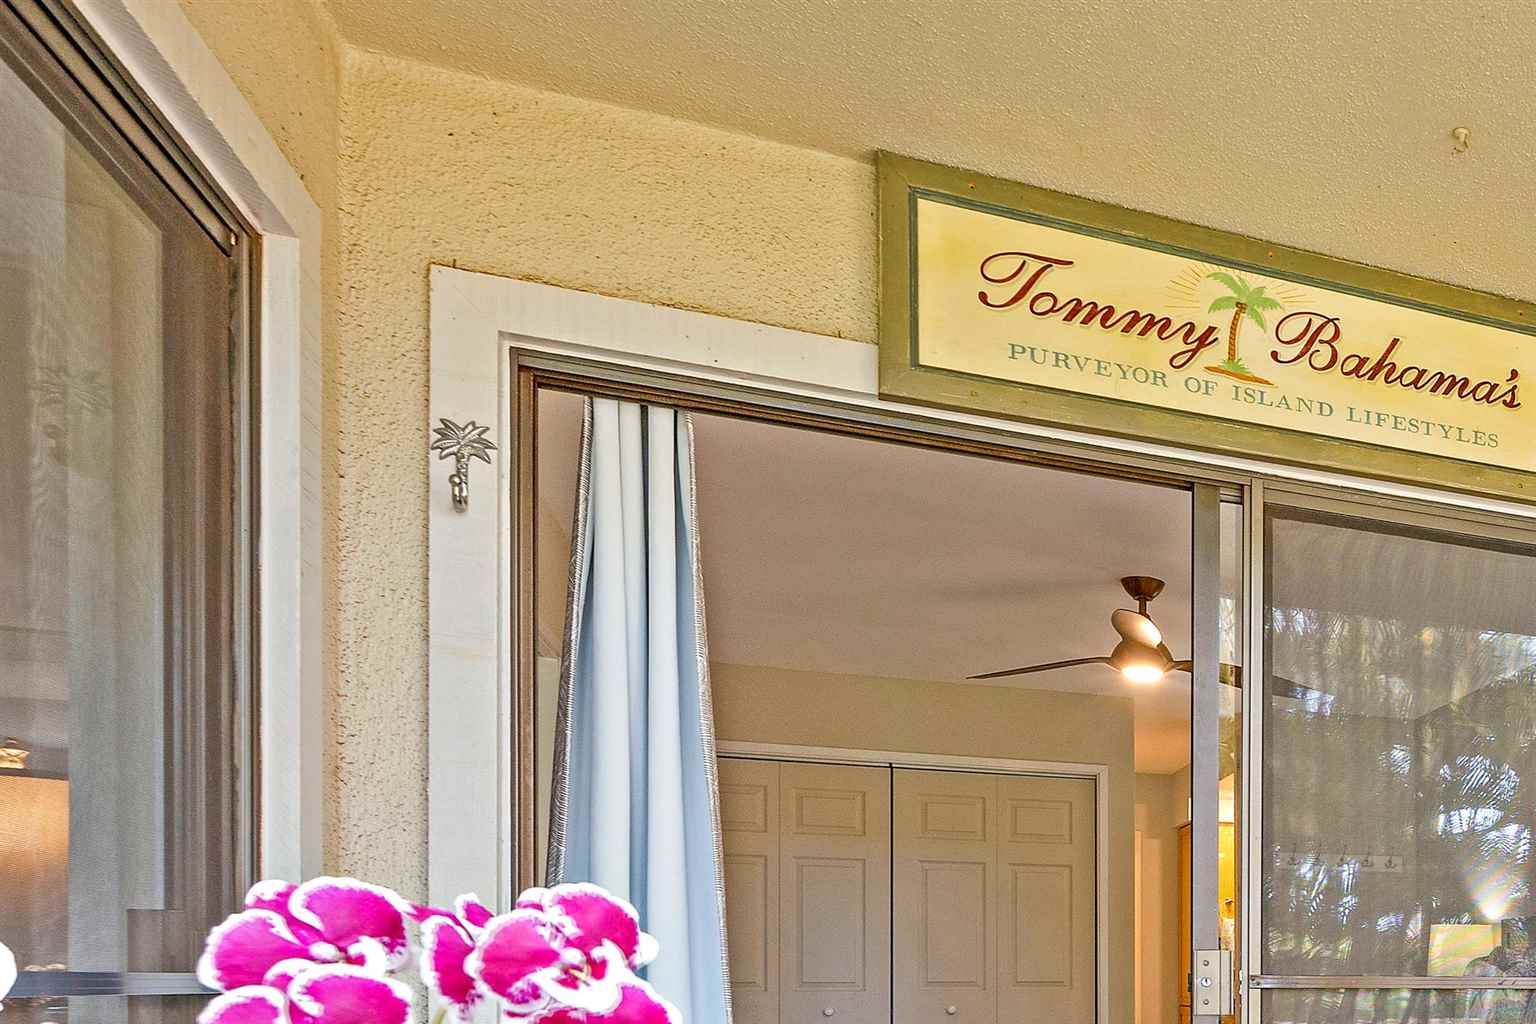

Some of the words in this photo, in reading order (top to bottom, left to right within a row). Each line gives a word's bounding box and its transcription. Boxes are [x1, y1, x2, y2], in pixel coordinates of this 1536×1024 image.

[978, 251, 1218, 369] Tommy
[1270, 311, 1521, 409] Bahama's
[1008, 343, 1168, 388] PURVEYOR
[1184, 376, 1218, 397] OF
[1231, 385, 1334, 417] ISLAND
[1346, 406, 1499, 448] LIFESTYLES
